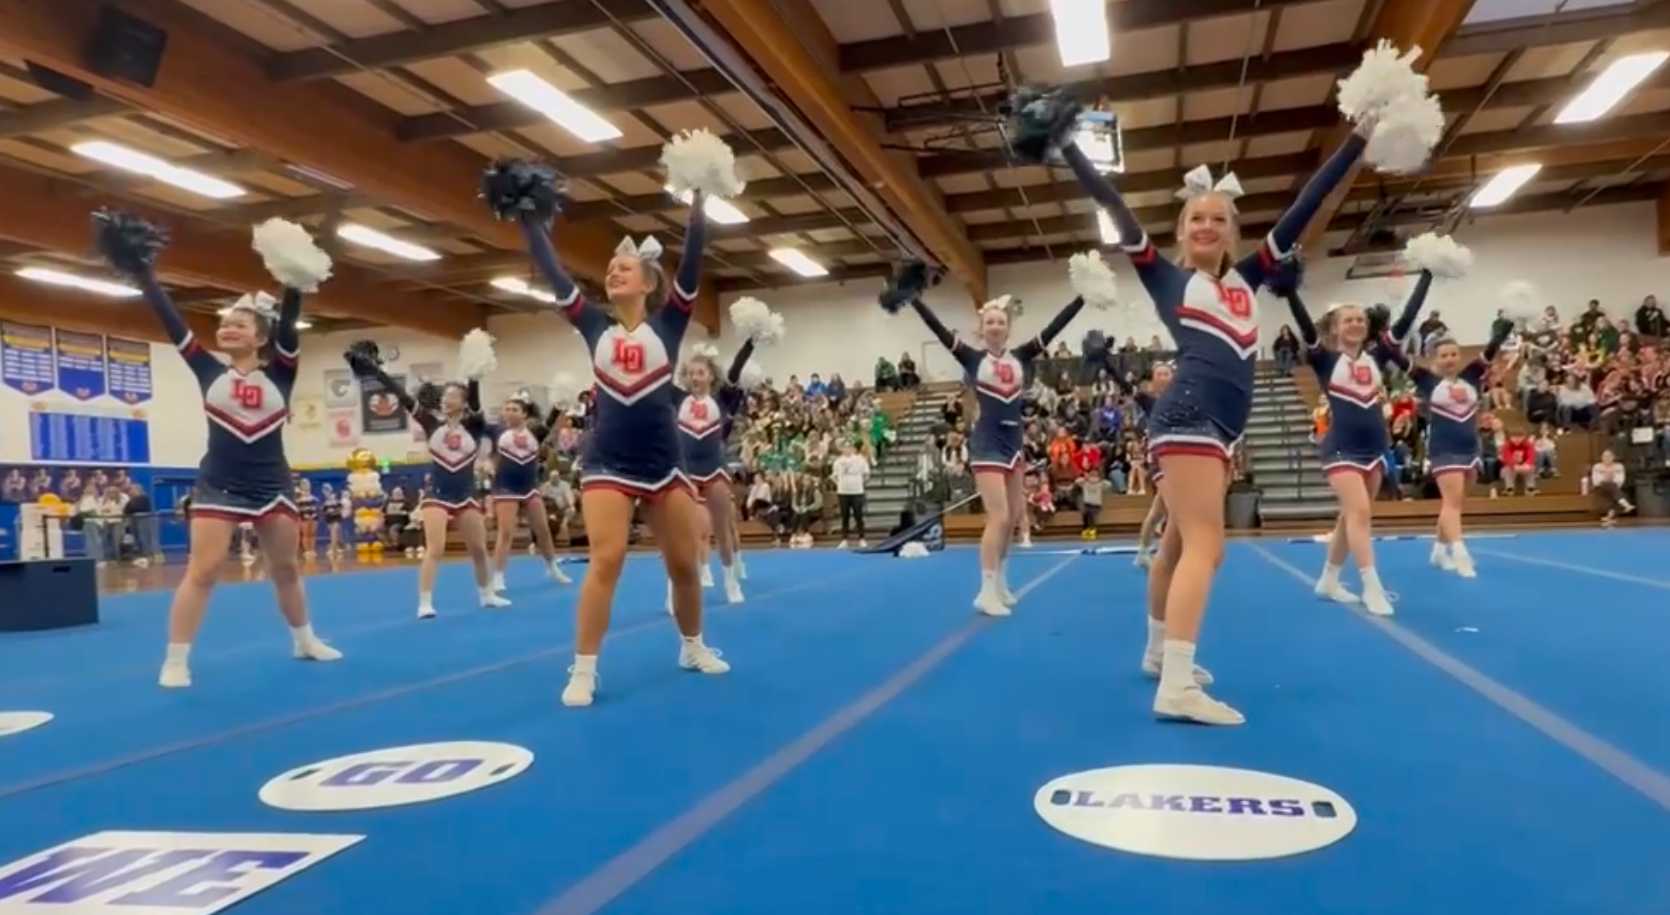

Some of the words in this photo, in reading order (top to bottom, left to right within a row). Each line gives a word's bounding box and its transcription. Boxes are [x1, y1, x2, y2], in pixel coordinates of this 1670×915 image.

[612, 338, 646, 373] LO
[231, 379, 263, 409] LO
[318, 759, 484, 787] GO
[1073, 789, 1305, 818] LAKERS
[0, 846, 312, 909] WE
